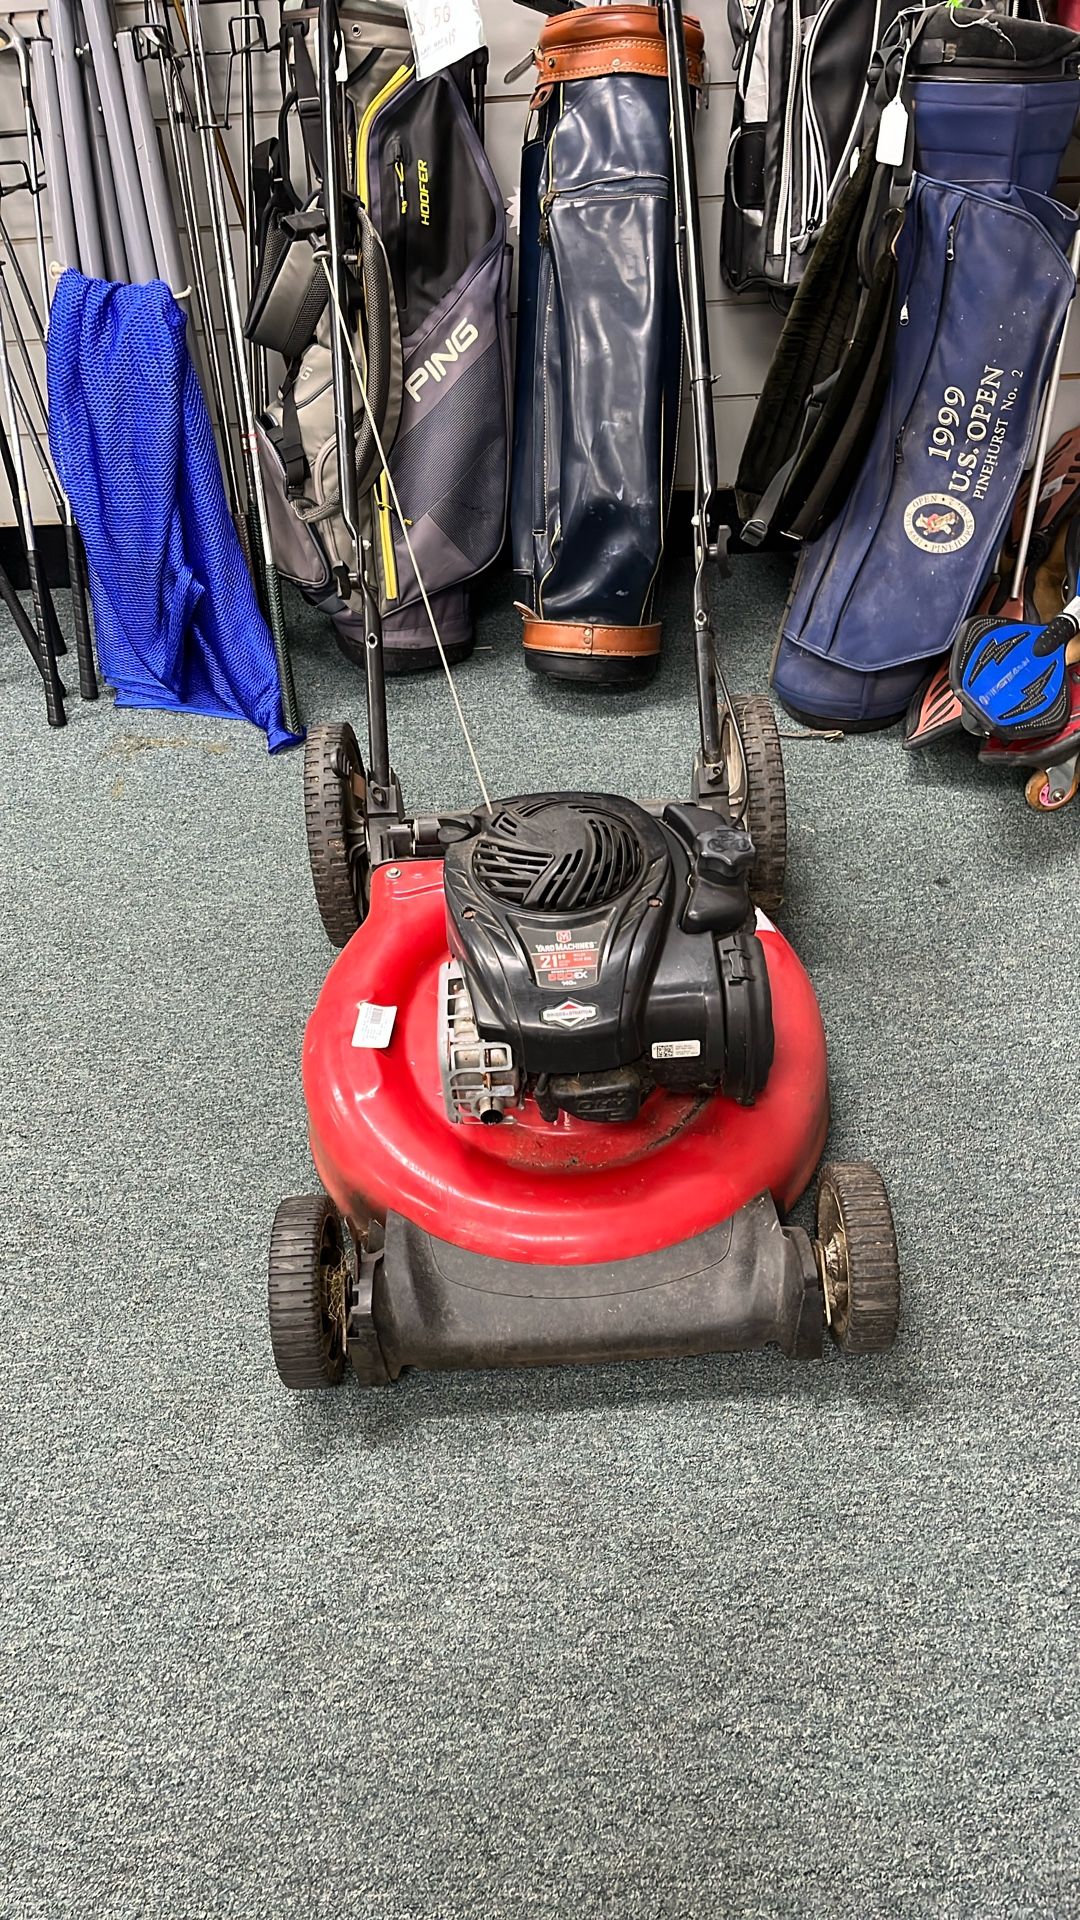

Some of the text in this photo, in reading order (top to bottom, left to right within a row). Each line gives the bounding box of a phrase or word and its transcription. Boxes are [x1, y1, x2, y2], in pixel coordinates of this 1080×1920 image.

[417, 159, 430, 226] HOOFER
[405, 317, 479, 402] PING
[928, 386, 966, 461] 1999
[948, 365, 1004, 493] U.S. OPEN
[973, 369, 1024, 500] PINEHURST No. 2
[912, 495, 937, 507] OPEN
[931, 519, 973, 552] PINEHURST
[535, 942, 594, 952] YARD MACHINES
